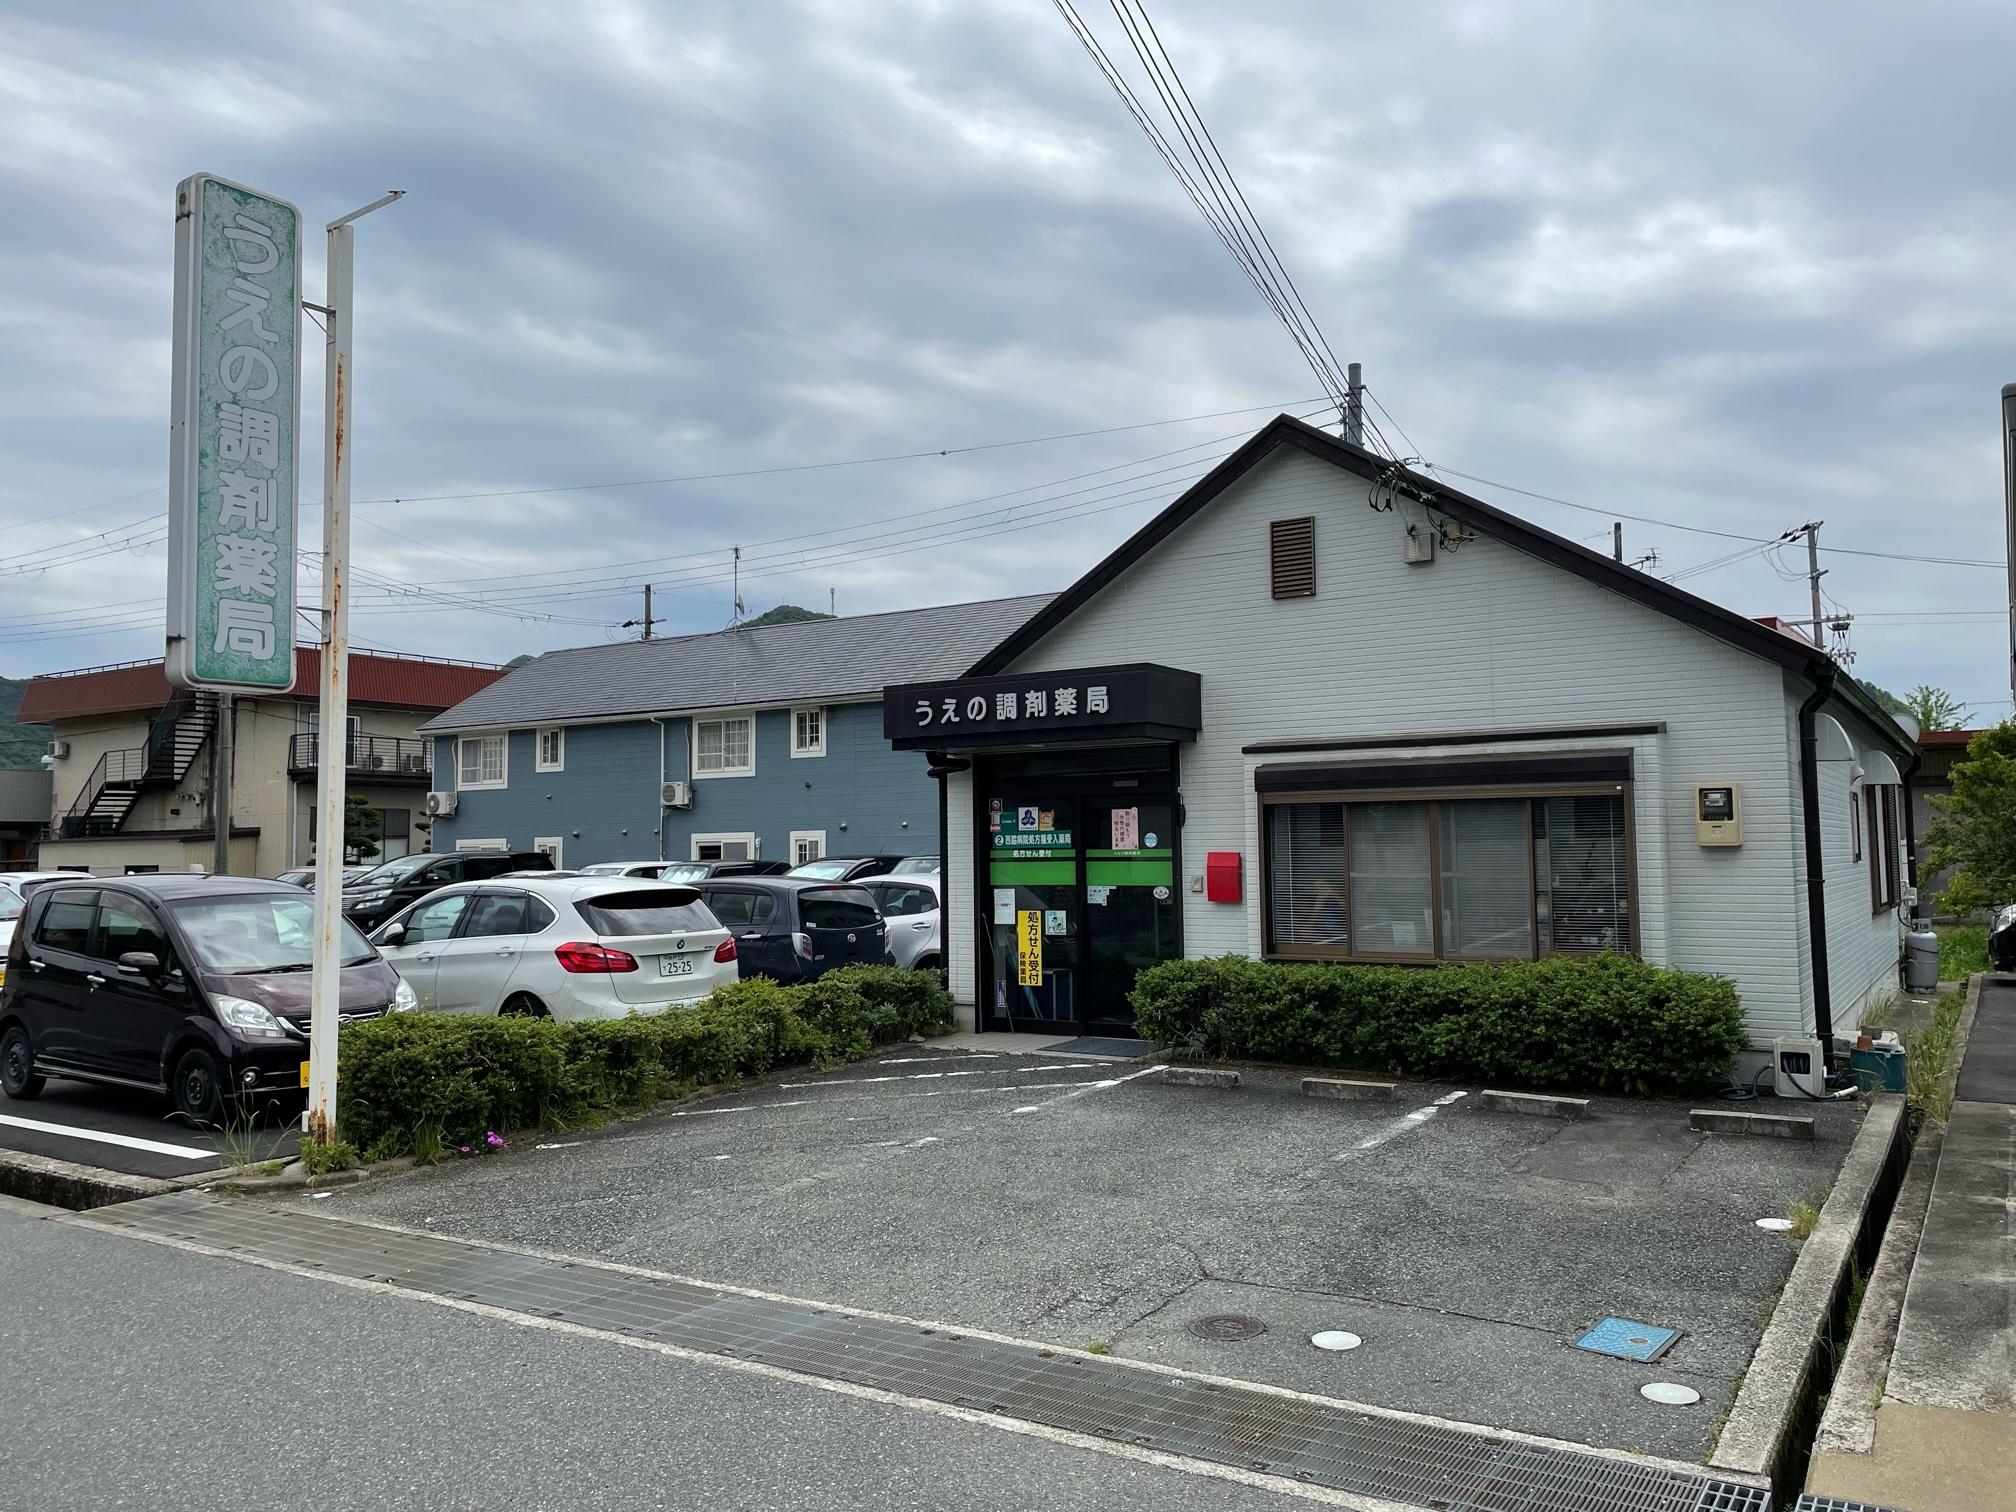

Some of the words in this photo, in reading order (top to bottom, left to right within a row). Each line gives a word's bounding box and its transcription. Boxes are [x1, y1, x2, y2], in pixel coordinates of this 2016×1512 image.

[213, 213, 280, 661] うえの調剤薬局
[915, 685, 1110, 727] うえの調剤薬局
[1012, 850, 1052, 858] 処方せん受付
[1028, 911, 1040, 985] 処方せん受付
